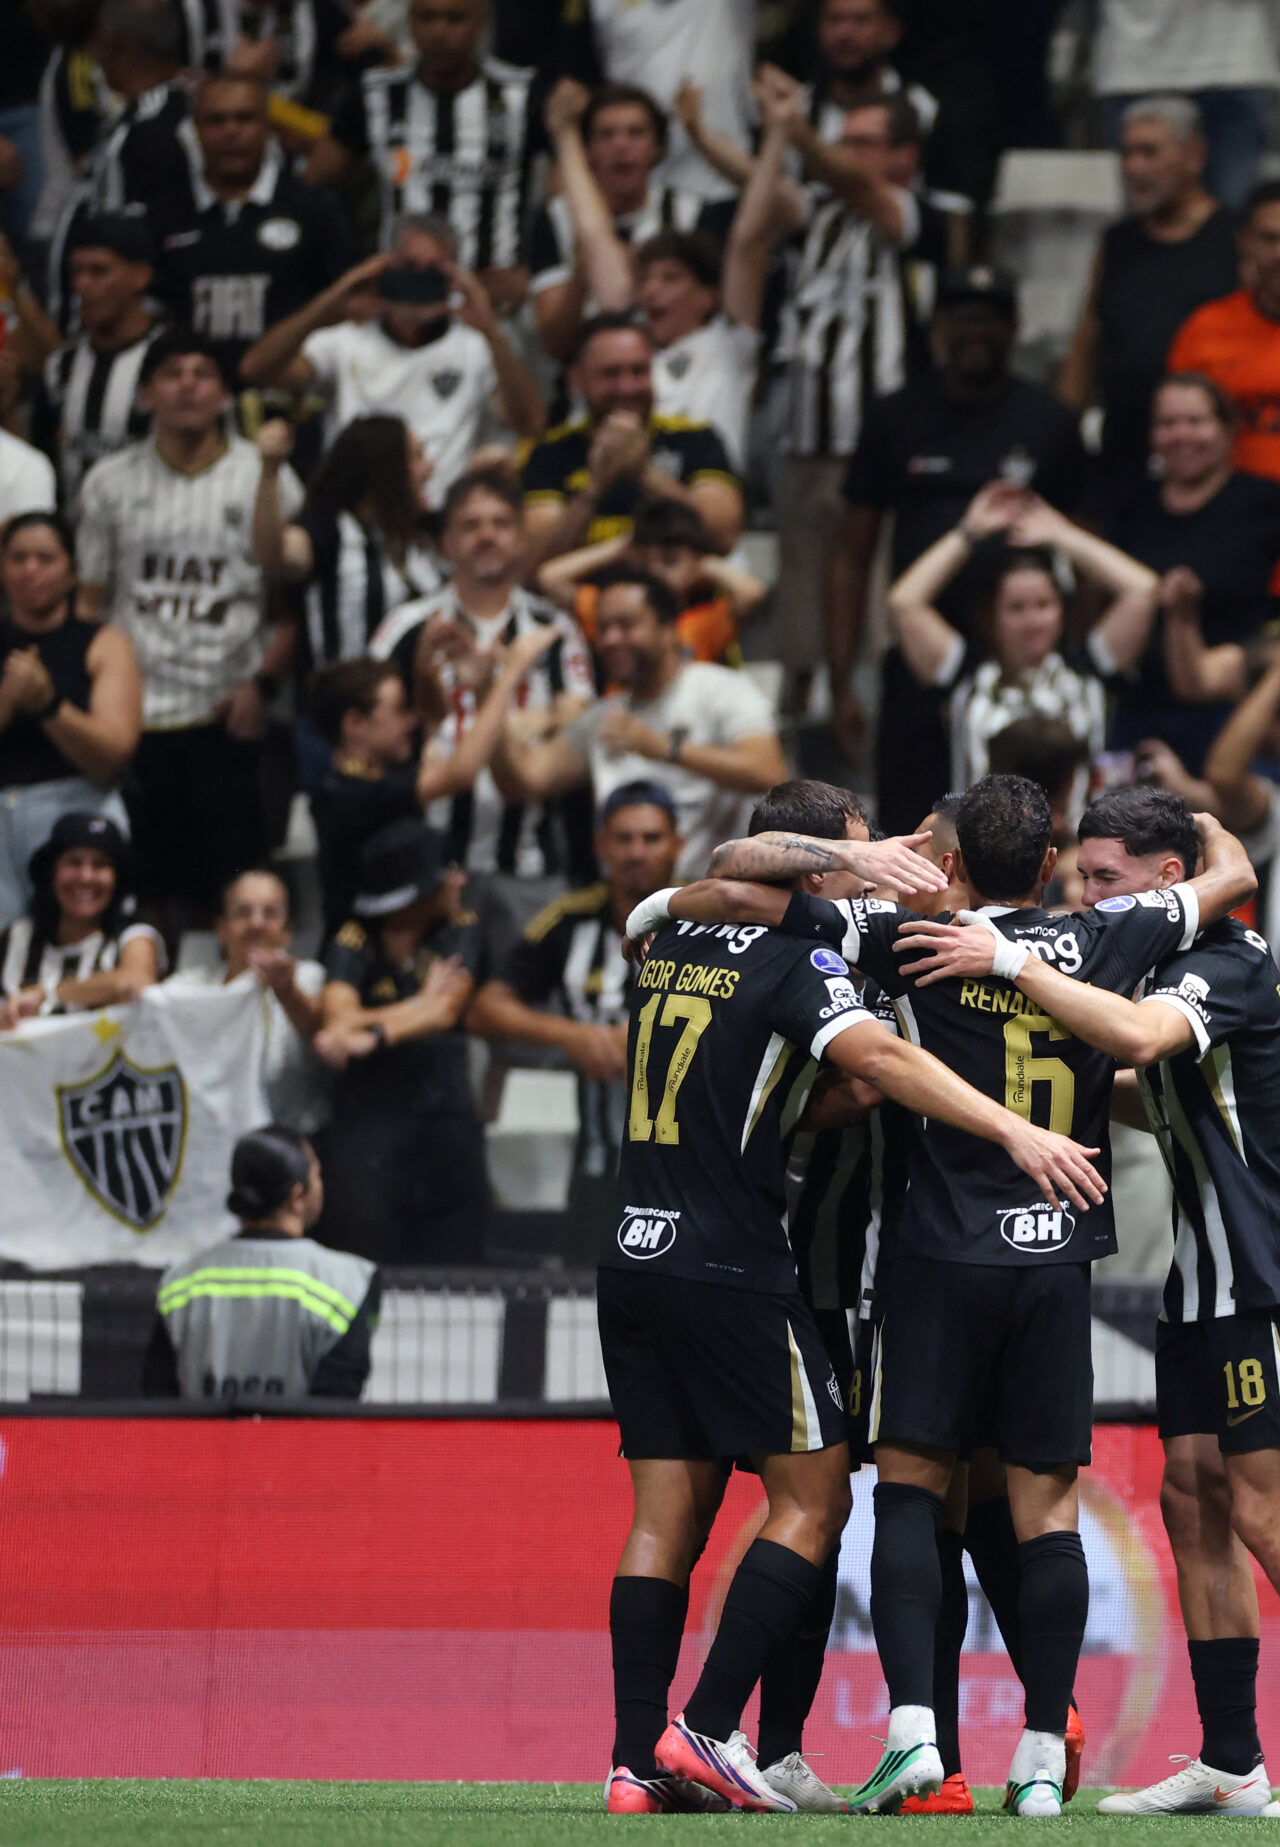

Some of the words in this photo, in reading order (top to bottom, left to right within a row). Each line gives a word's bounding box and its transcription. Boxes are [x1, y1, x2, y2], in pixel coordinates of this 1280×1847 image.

[143, 552, 229, 585] FIAT
[851, 897, 869, 933] DAU
[638, 959, 676, 990] IGOR
[675, 963, 741, 999] GOMES
[628, 993, 713, 1145] 17
[636, 1041, 646, 1092] mundiale
[668, 1047, 692, 1093] mundiale
[1003, 1013, 1075, 1137] 6
[1013, 1054, 1025, 1103] mundiale
[622, 1218, 667, 1249] BH
[1012, 1211, 1063, 1243] BH
[1223, 1358, 1267, 1408] 18
